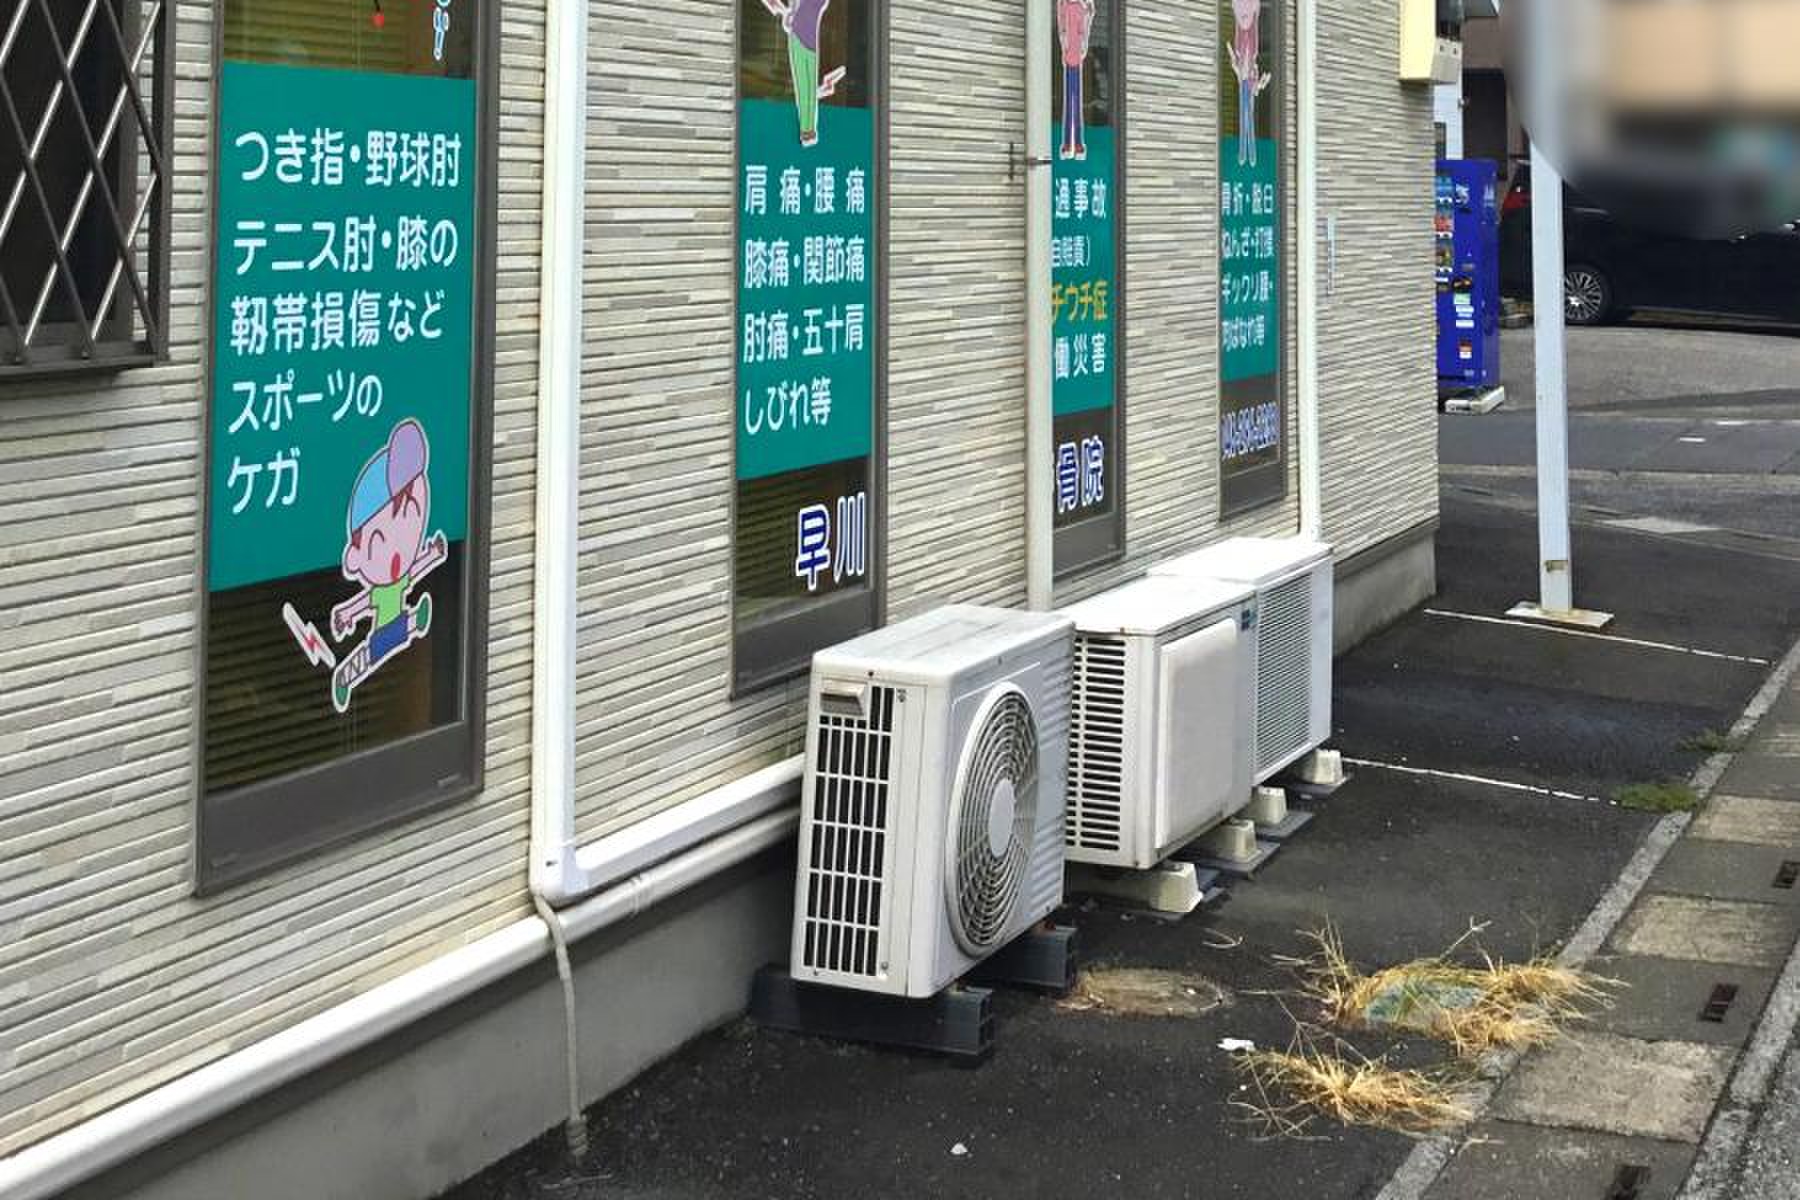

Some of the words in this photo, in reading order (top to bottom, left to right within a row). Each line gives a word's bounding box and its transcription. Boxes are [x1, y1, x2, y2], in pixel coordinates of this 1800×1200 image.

[235, 127, 462, 188] つき指・野球肘
[233, 214, 458, 276] テニス肘・膝の
[744, 233, 866, 290] 膝痛・関節痛
[743, 303, 865, 364] 肘痛・五十肩
[228, 368, 383, 434] スポーツの
[744, 376, 832, 435] しびれ等
[227, 447, 301, 515] ケガ
[796, 491, 866, 591] 早川
